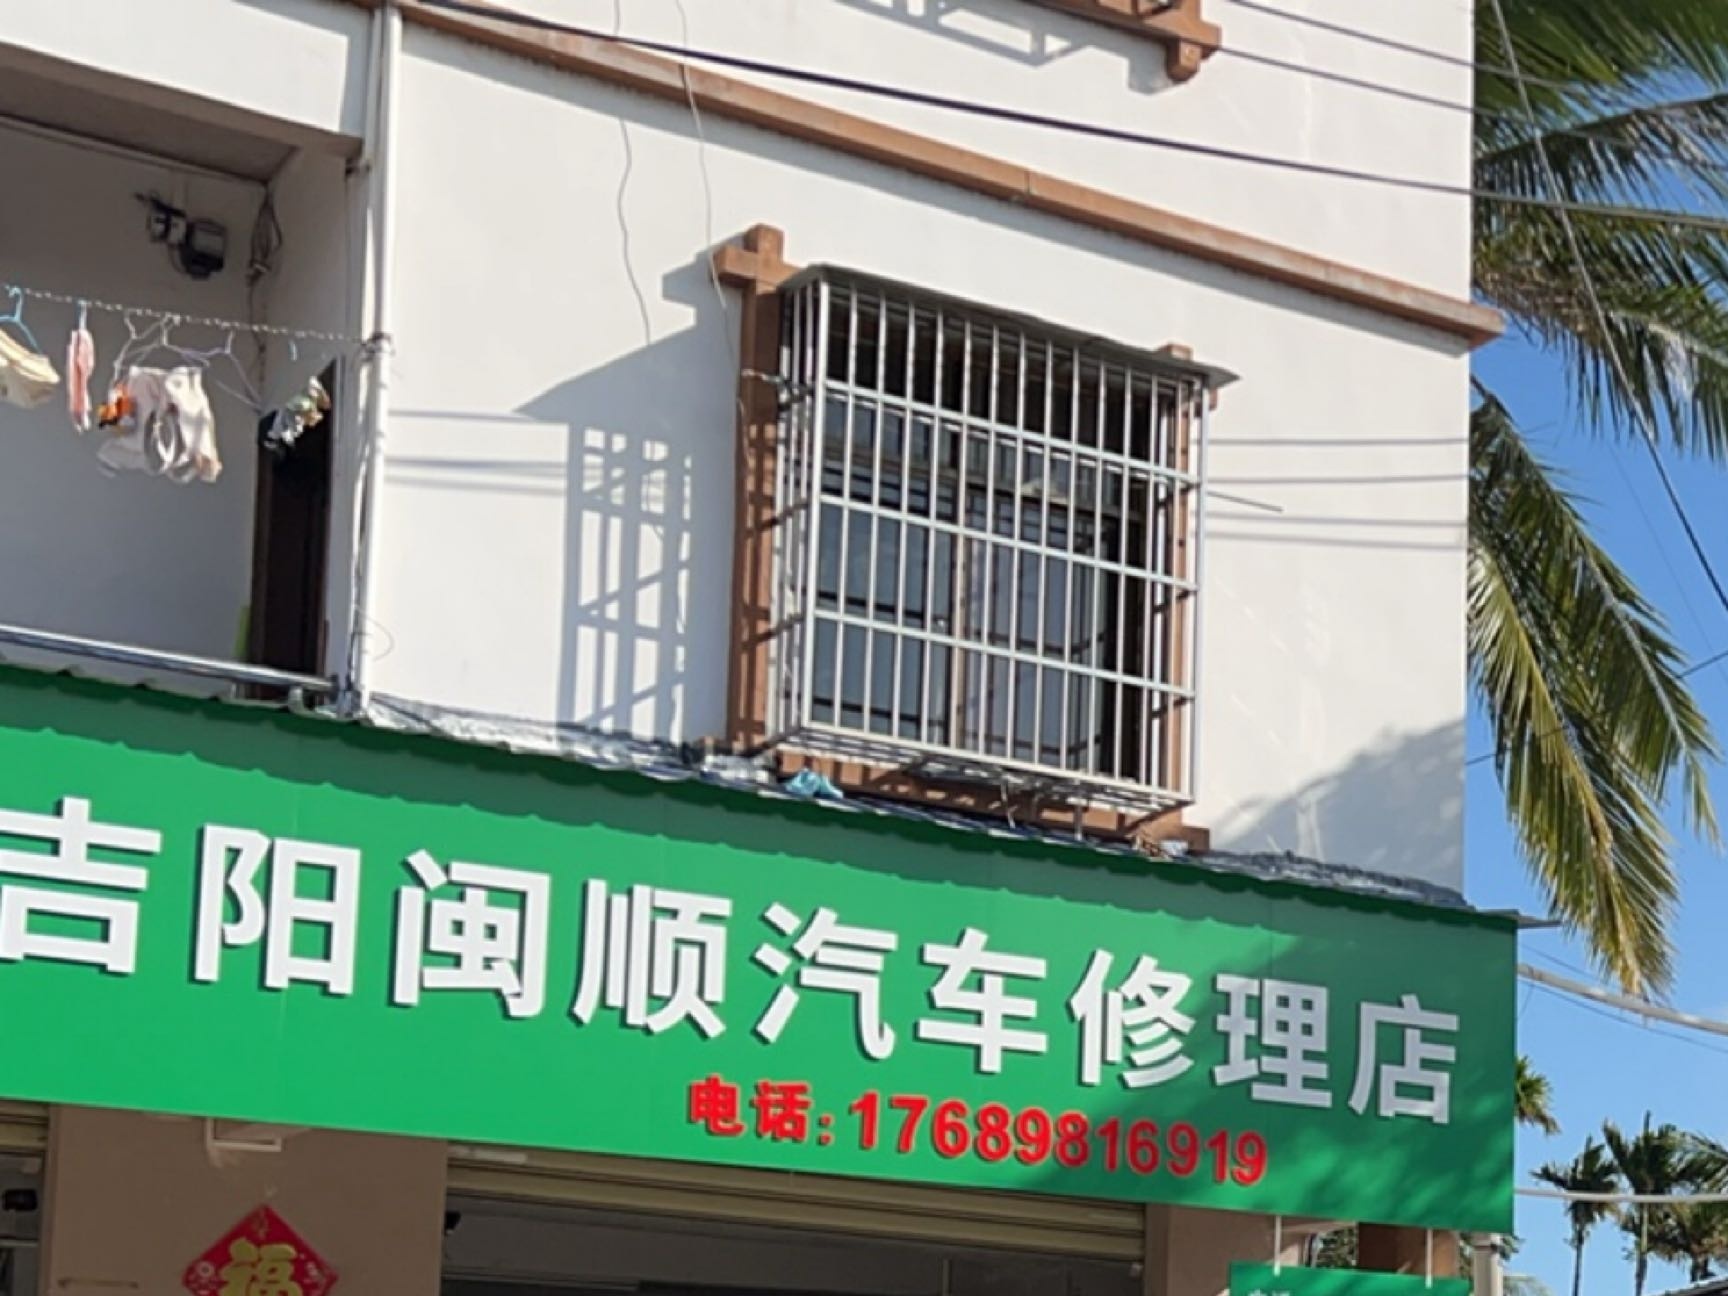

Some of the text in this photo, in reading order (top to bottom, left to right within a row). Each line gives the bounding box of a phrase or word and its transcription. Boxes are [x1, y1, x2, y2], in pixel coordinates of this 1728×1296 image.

[0, 797, 1460, 1124] 吉阳闽顺汽车修理店
